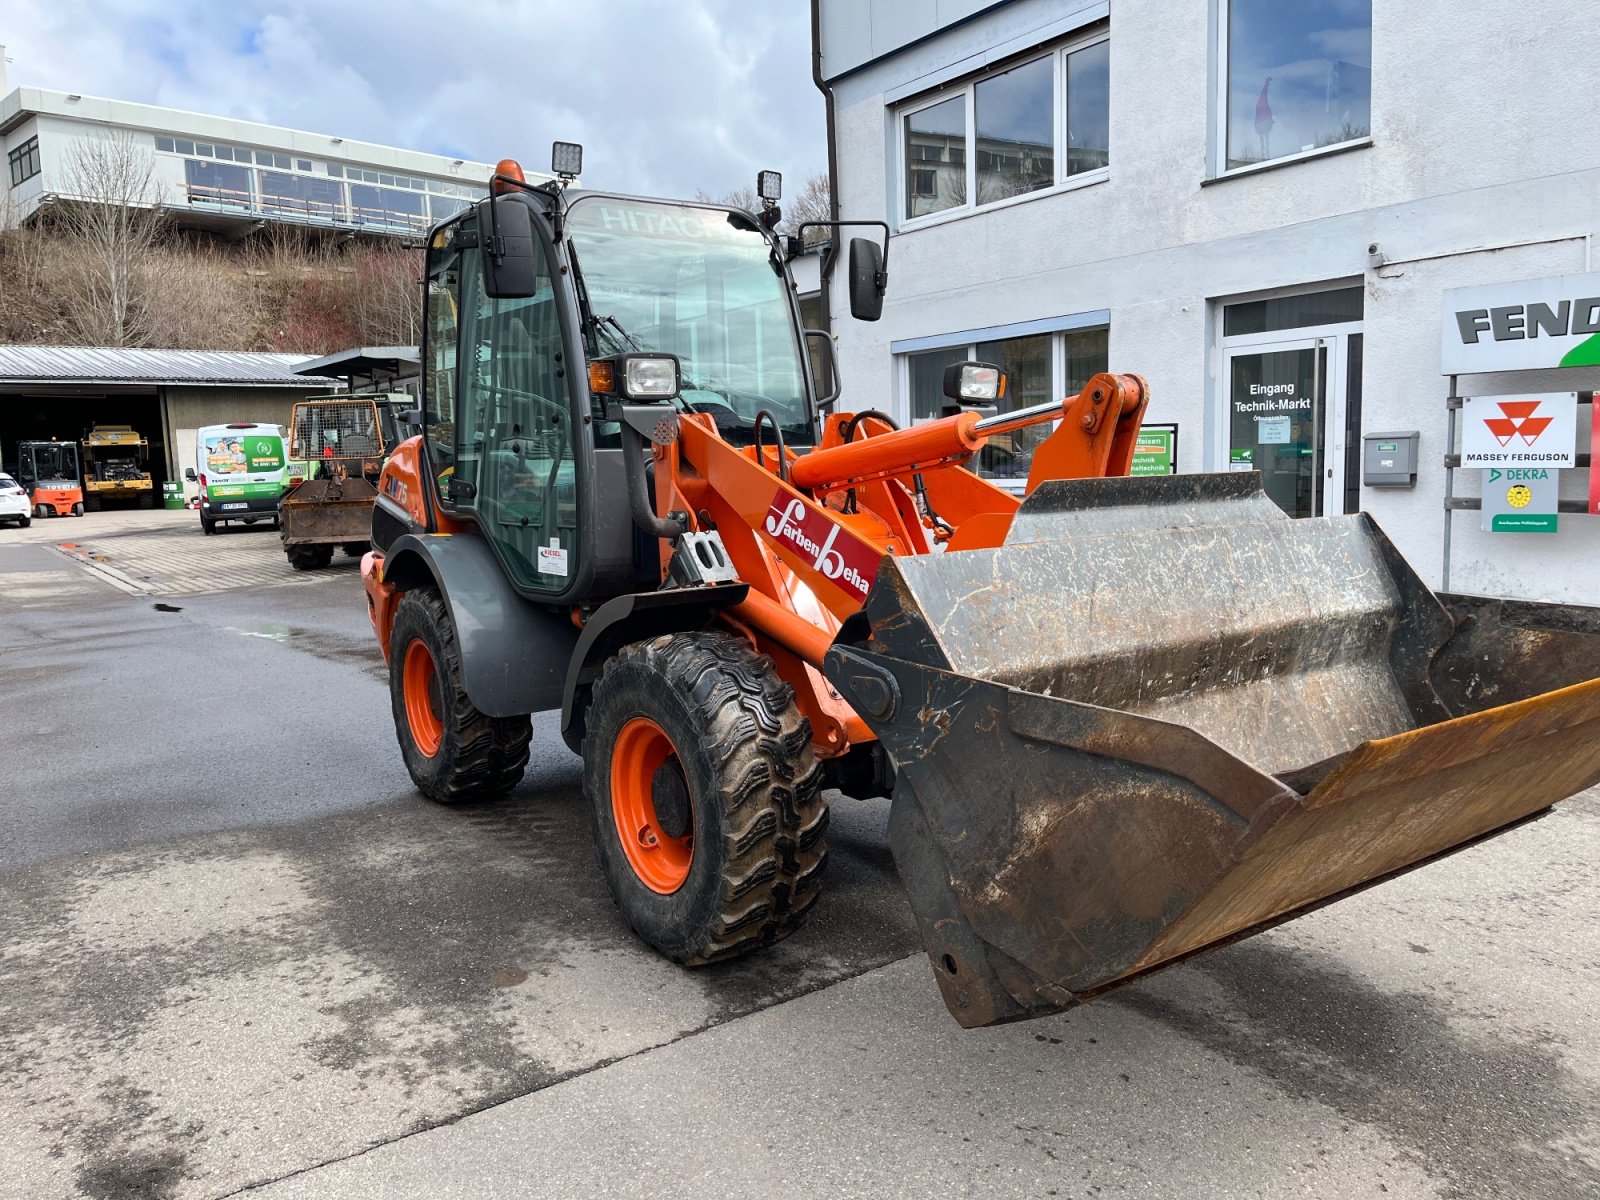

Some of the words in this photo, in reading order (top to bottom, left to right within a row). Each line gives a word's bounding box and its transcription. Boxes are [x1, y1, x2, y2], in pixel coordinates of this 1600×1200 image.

[600, 207, 737, 241] HITAC
[1250, 384, 1294, 396] Eingang
[1235, 398, 1311, 412] Technik-Markt
[1507, 469, 1548, 480] DEKRA
[544, 549, 561, 557] KIESEL
